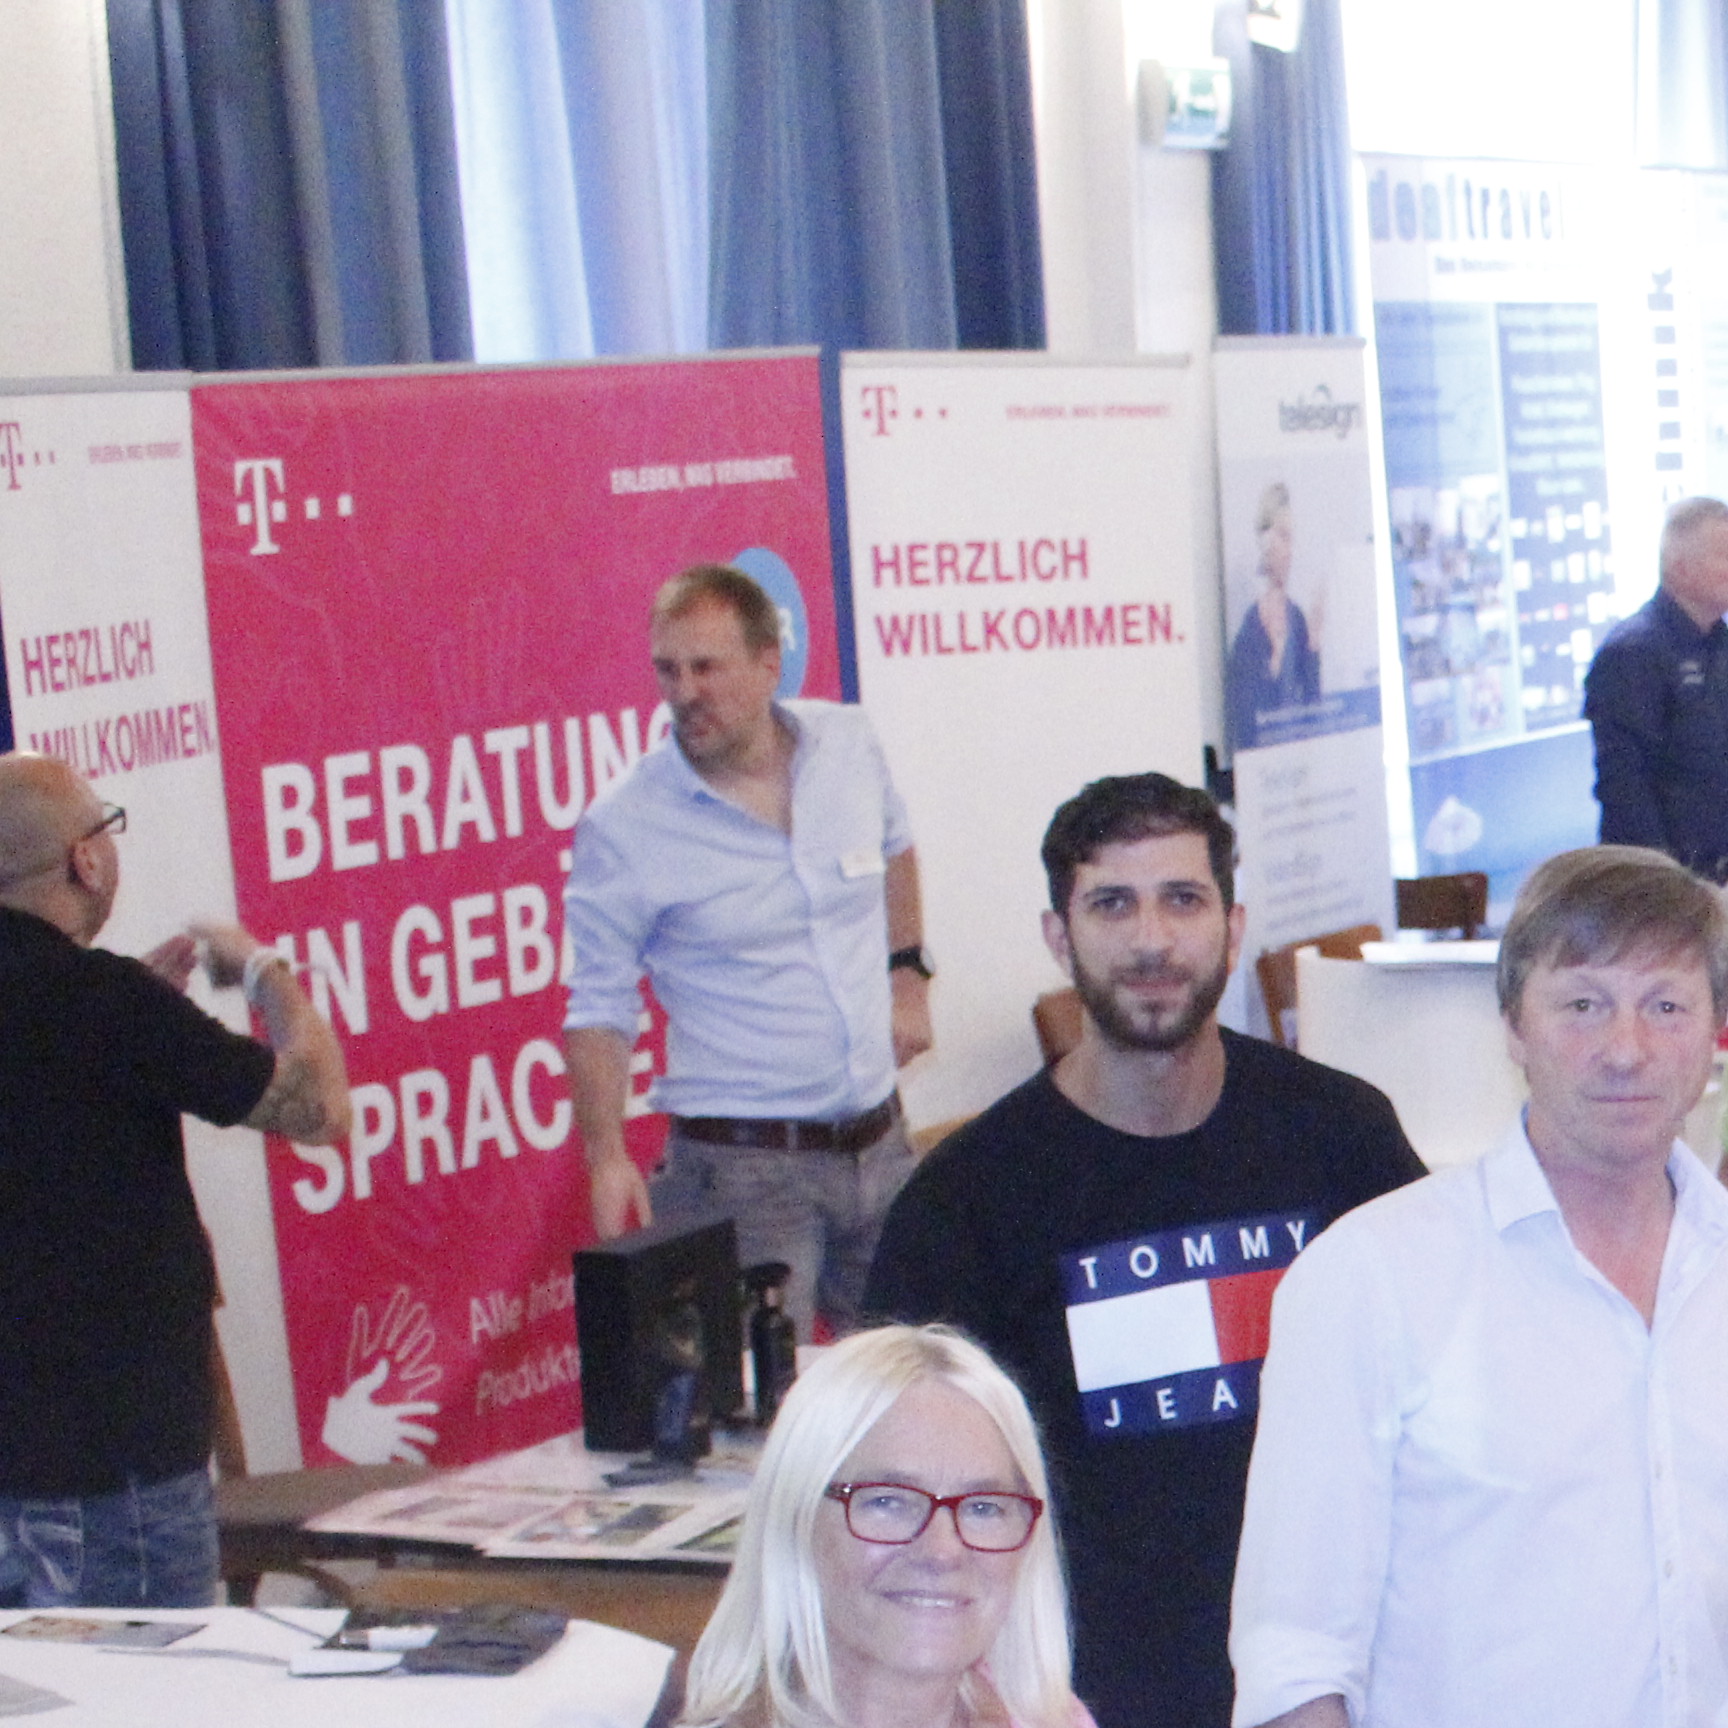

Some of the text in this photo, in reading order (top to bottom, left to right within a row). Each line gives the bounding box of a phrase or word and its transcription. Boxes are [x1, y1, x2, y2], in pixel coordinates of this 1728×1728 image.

[871, 538, 1090, 588] HERZLICH
[19, 618, 155, 696] HERZLICH
[874, 603, 1186, 658] WILLKOMMEN.
[276, 921, 369, 1036] N
[1078, 1219, 1306, 1289] TOMMY
[1103, 1378, 1239, 1429] JEA
